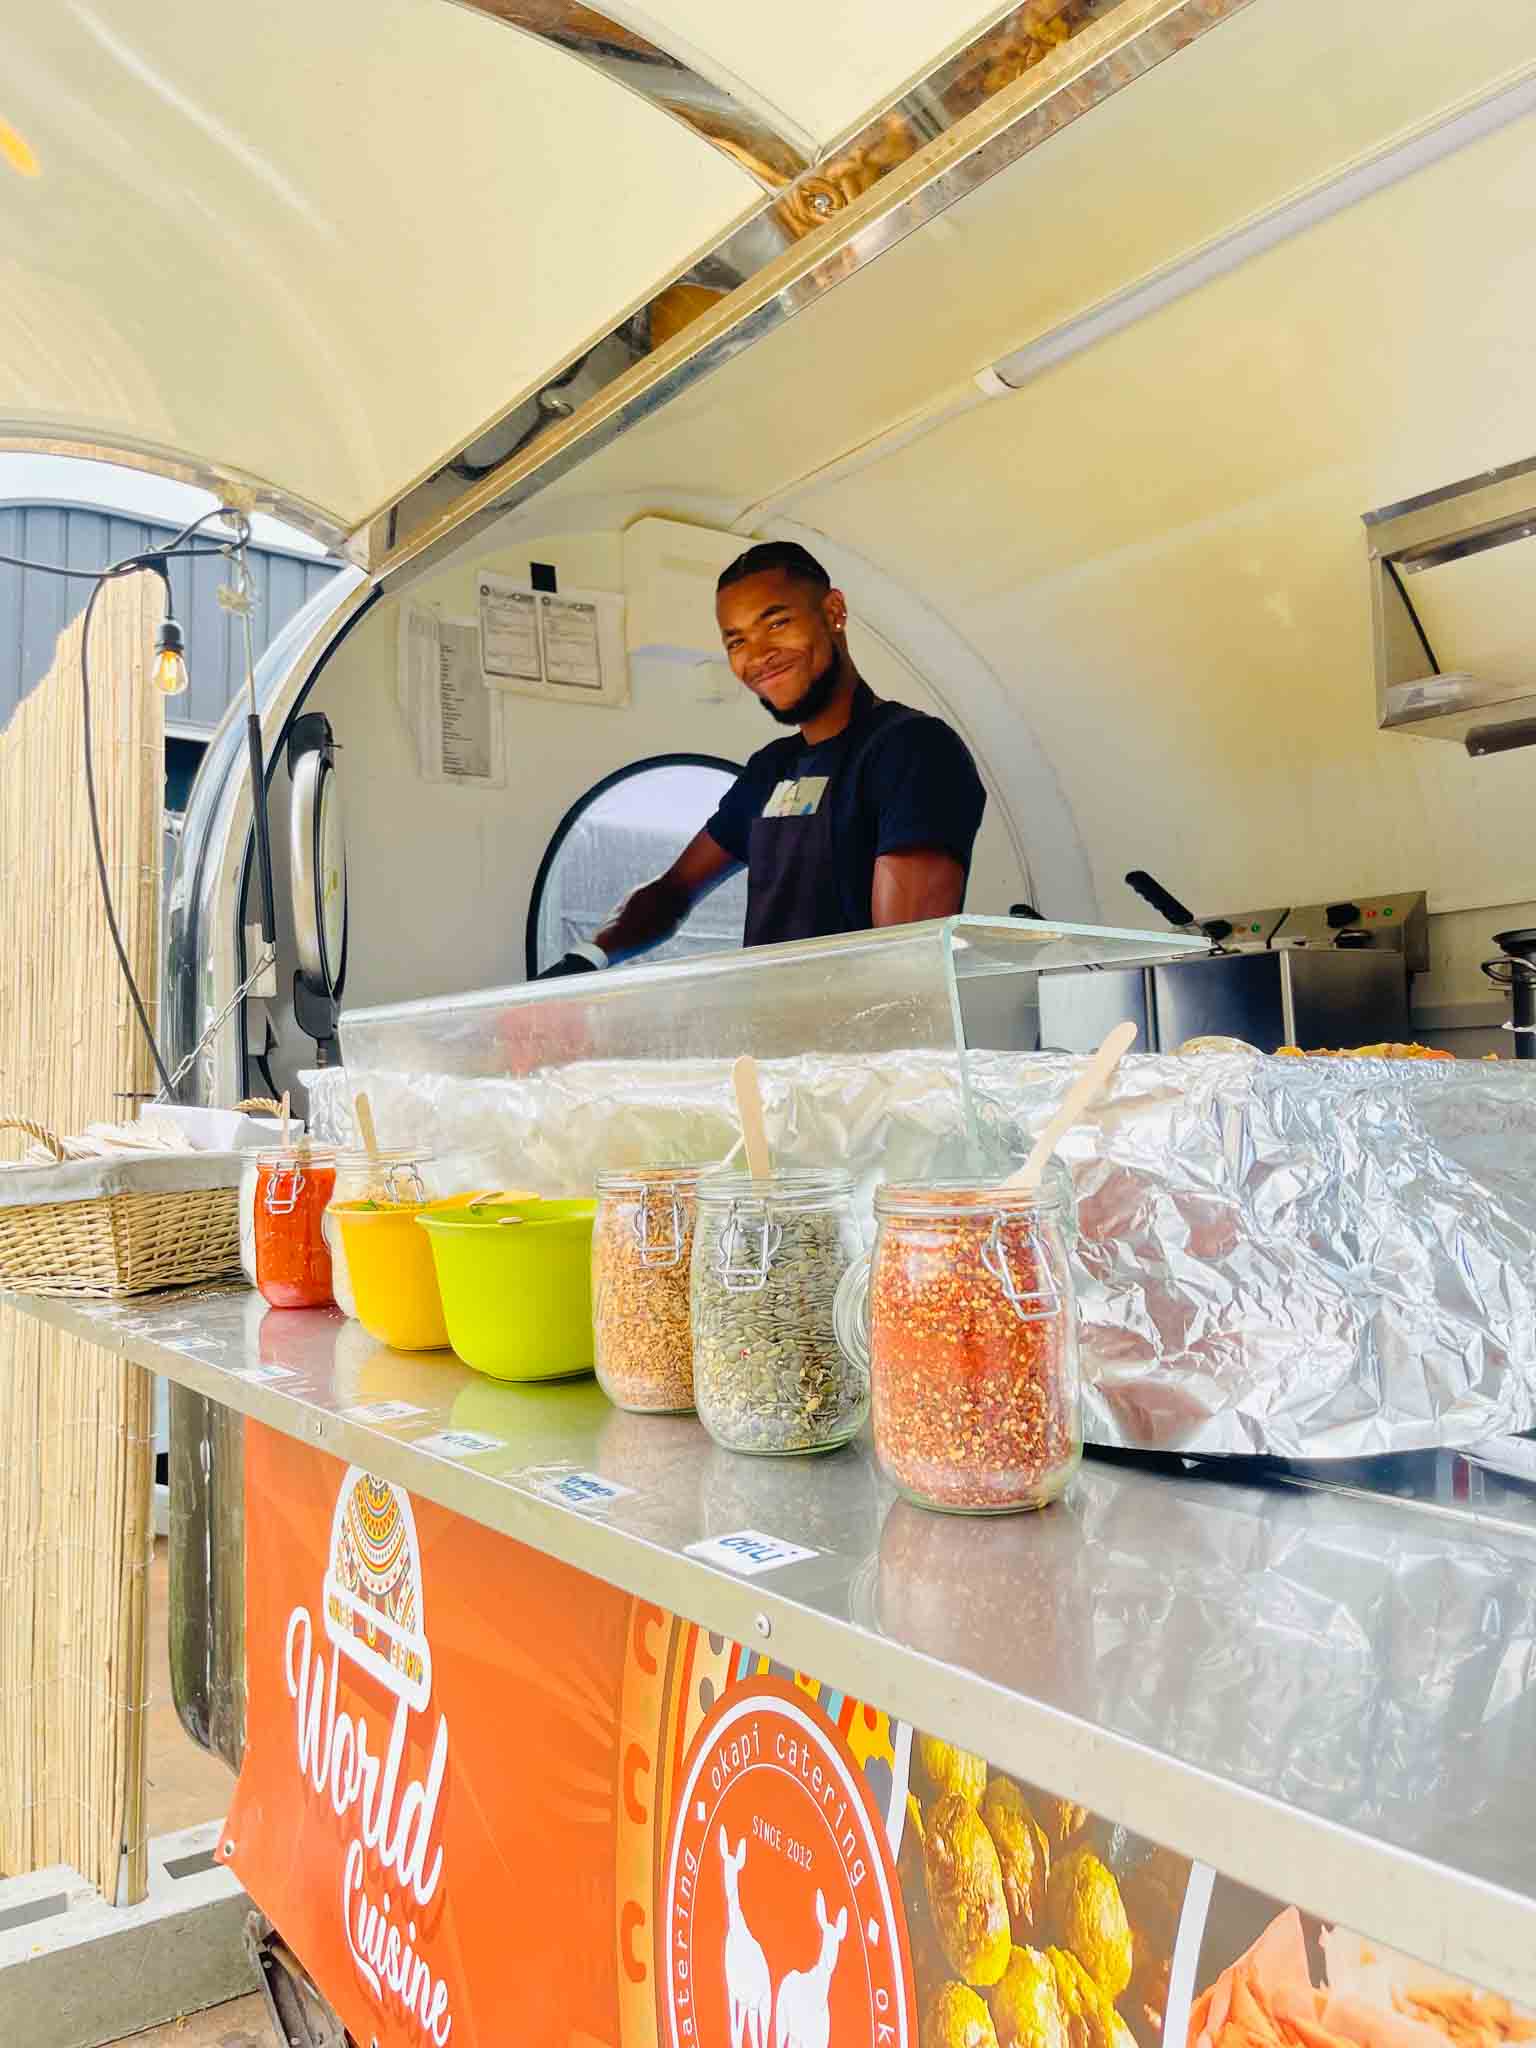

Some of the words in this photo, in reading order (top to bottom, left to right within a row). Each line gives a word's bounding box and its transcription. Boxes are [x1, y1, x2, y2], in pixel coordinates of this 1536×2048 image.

[286, 1606, 448, 1905] World
[710, 1722, 762, 1790] okapi
[775, 1732, 867, 1888] catering
[752, 1815, 782, 1851] SINCE
[786, 1838, 813, 1871] 2012
[344, 1839, 452, 2047] Cuisine
[676, 1847, 698, 2048] atering
